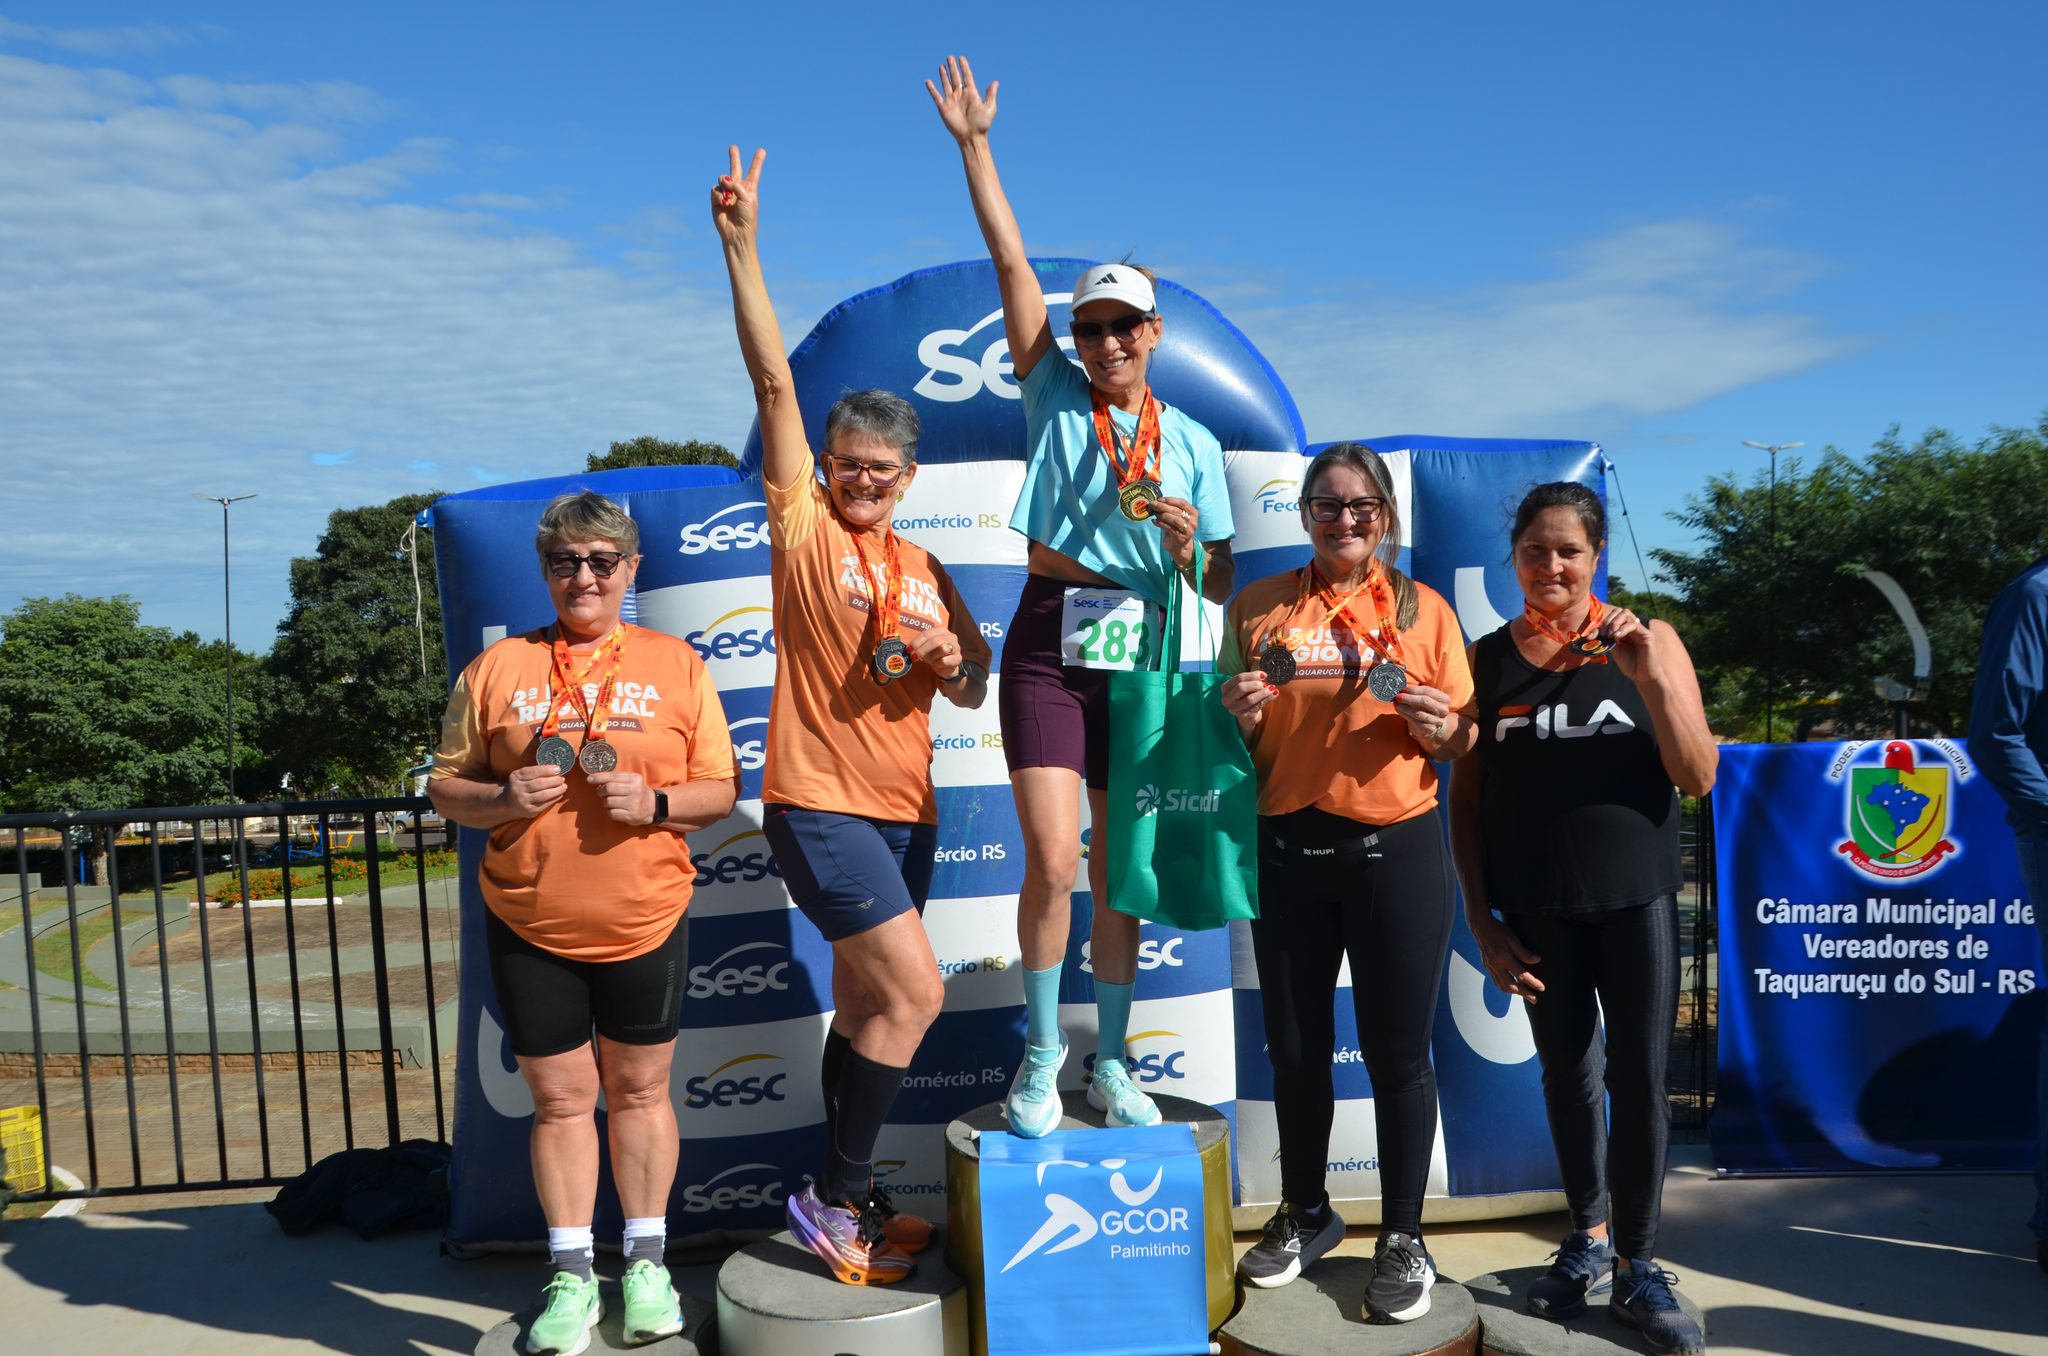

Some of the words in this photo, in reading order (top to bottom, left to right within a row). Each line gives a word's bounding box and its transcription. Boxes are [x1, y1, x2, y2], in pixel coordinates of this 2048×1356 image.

[892, 514, 973, 530] comércio
[979, 513, 1001, 528] RS
[980, 622, 1003, 637] RS
[1076, 618, 1150, 664] 283
[621, 720, 637, 728] SUL
[1496, 699, 1635, 742] FILA
[981, 733, 1003, 748] RS
[982, 844, 1006, 860] RS
[1756, 897, 1858, 924] Câmara
[1866, 898, 1996, 930] Municipal
[2004, 899, 2036, 924] de
[1803, 934, 1949, 959] Vereadores
[1956, 934, 1989, 959] de
[983, 956, 1006, 972] RS
[1754, 968, 1886, 999] Taquaruçu
[1894, 968, 1926, 993] do
[1934, 968, 1975, 993] Sul
[1998, 969, 2036, 994] RS
[982, 1067, 1006, 1084] RS
[1100, 1207, 1190, 1236] GCOR
[1110, 1242, 1191, 1259] Palmitinho
